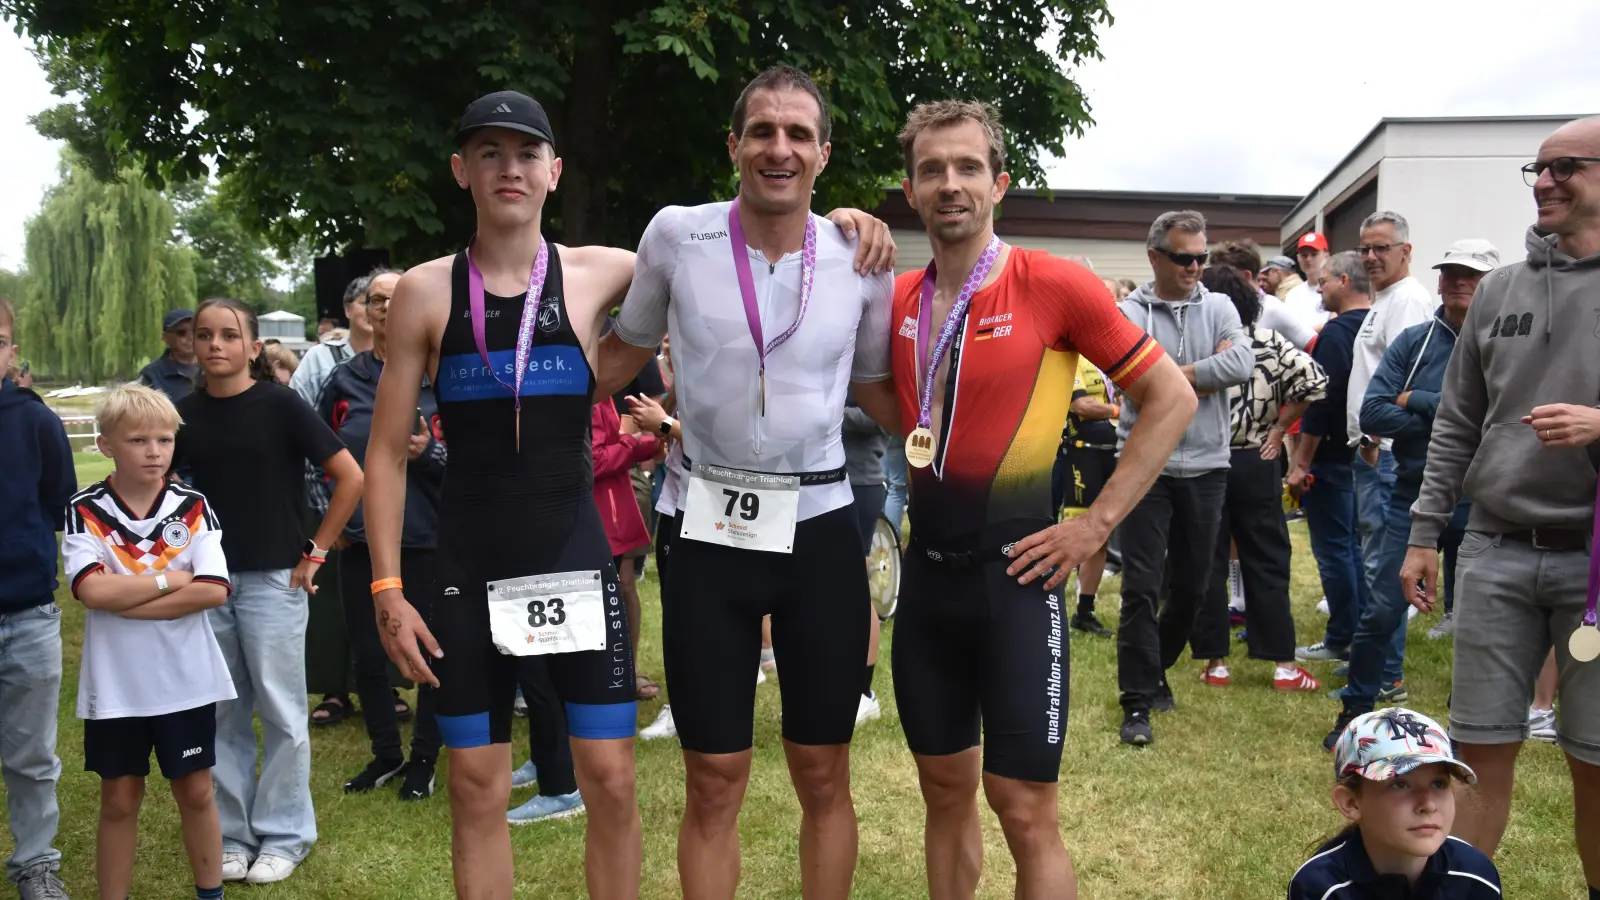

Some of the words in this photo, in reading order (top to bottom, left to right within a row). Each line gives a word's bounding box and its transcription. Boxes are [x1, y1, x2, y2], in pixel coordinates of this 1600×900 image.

[690, 230, 728, 241] FUSION
[463, 309, 501, 319] BICER
[519, 303, 537, 360] Feuchtwangen
[528, 285, 538, 303] 2026
[979, 313, 1013, 326] BIORACER
[929, 319, 955, 376] Feuchtwangen
[951, 300, 964, 320] 2026
[993, 325, 1013, 338] GER
[450, 355, 573, 380] kern.seck.
[708, 466, 758, 483] Feuchtwanger
[759, 475, 793, 485] Triathlon
[722, 489, 760, 521] 79
[507, 580, 560, 593] Feuchtwanger
[561, 578, 594, 587] Triathlon
[527, 598, 567, 628] 83
[1045, 594, 1062, 745] quadrathlon-allianz.de
[182, 746, 203, 758] JAKO
